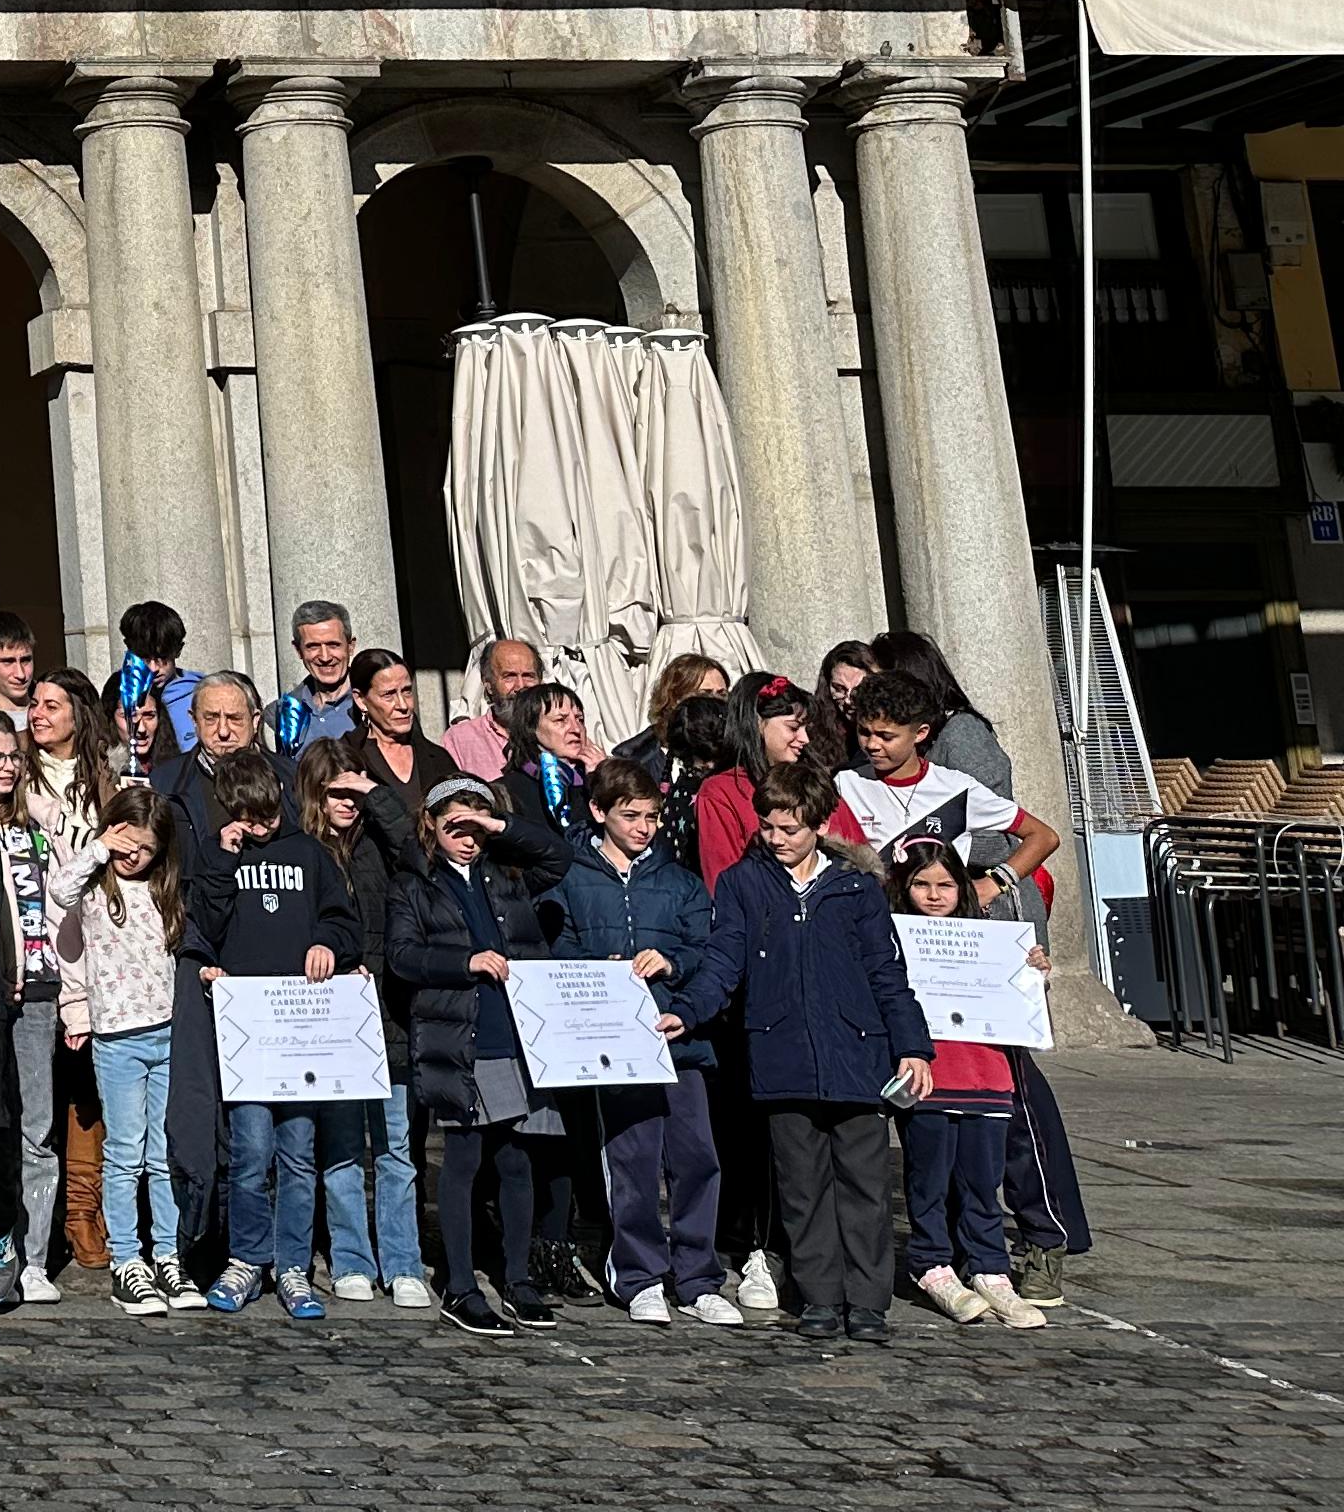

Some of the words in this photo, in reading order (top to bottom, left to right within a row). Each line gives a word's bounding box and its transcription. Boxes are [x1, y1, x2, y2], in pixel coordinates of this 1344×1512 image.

[1311, 505, 1334, 522] RB
[926, 821, 943, 833] 73
[919, 947, 932, 955] DE
[935, 947, 955, 956] AÑO
[281, 979, 306, 987] PREM
[273, 1008, 286, 1016] DE
[289, 1007, 308, 1016] AÑO
